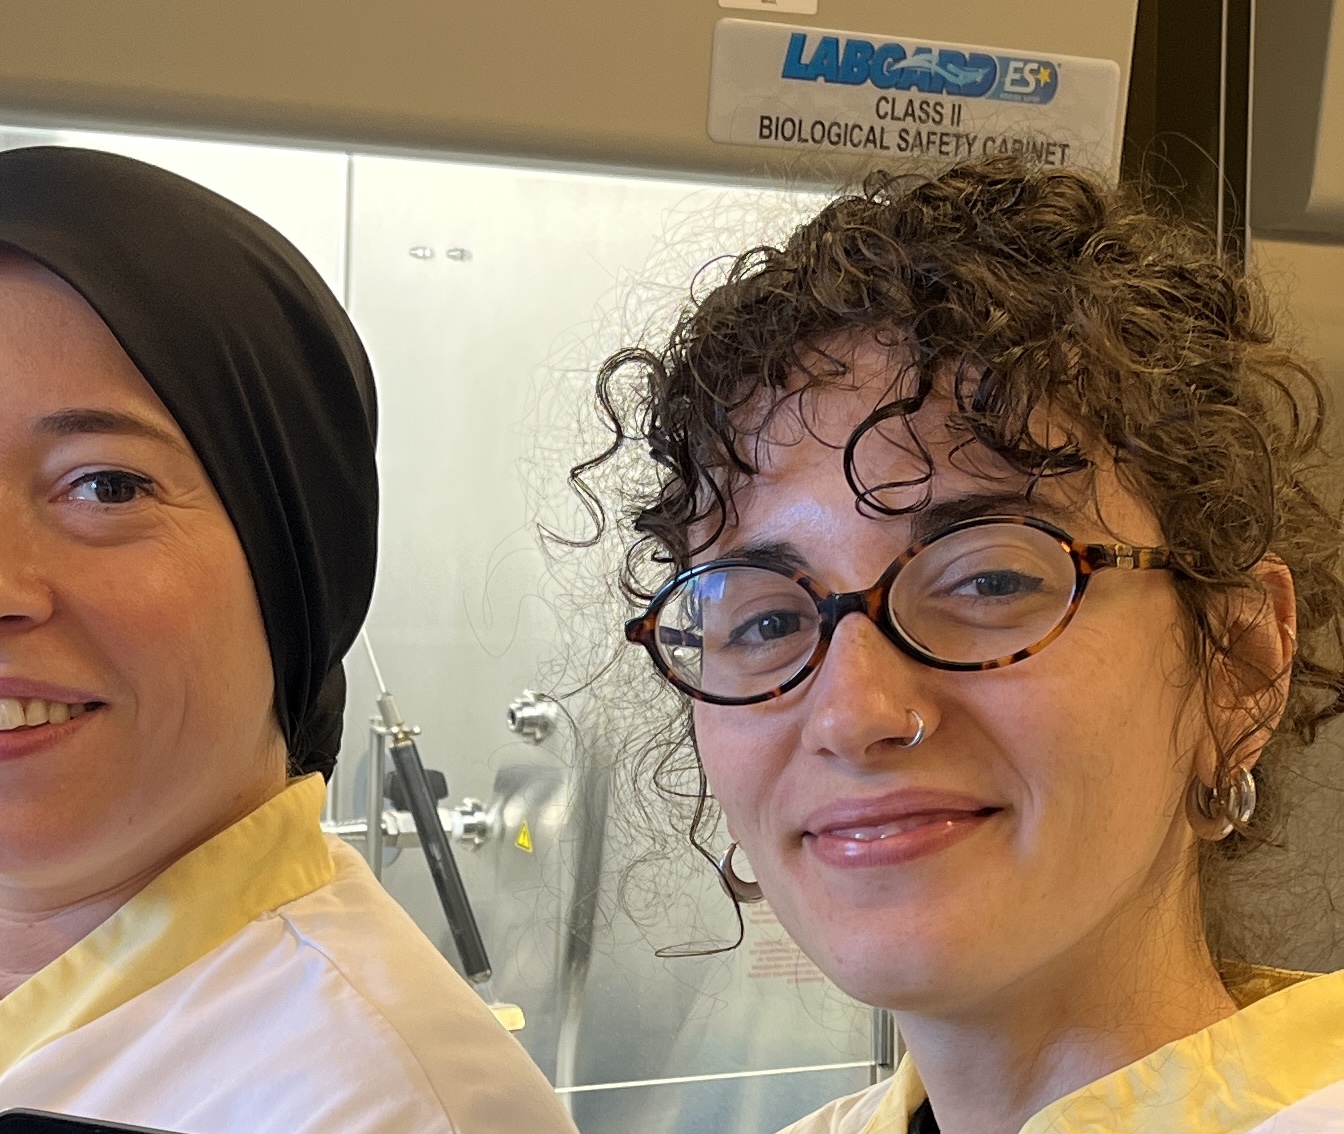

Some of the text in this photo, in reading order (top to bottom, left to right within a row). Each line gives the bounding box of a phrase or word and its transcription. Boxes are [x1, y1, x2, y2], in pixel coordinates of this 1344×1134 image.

[1004, 60, 1039, 94] ES
[875, 95, 962, 127] CLASS II
[758, 115, 891, 150] BIOLOGICAL
[897, 127, 977, 157] SAFETY
